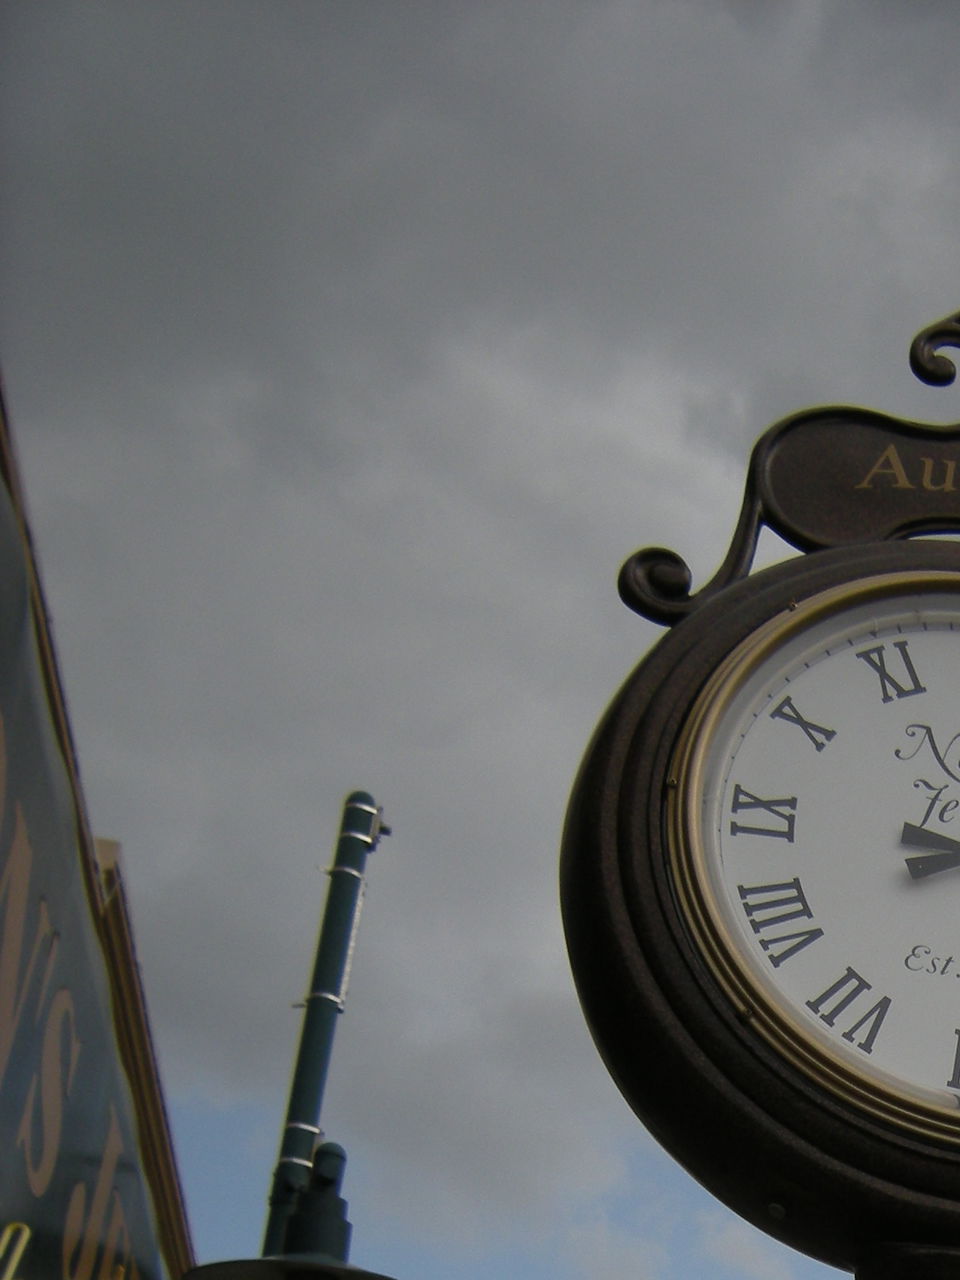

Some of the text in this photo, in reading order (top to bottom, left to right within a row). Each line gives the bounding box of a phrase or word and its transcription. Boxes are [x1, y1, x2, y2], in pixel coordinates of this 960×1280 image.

[856, 639, 927, 703] XI
[771, 696, 838, 751] X
[730, 784, 798, 843] IX
[738, 877, 825, 968] VIII
[805, 967, 894, 1055] VII
